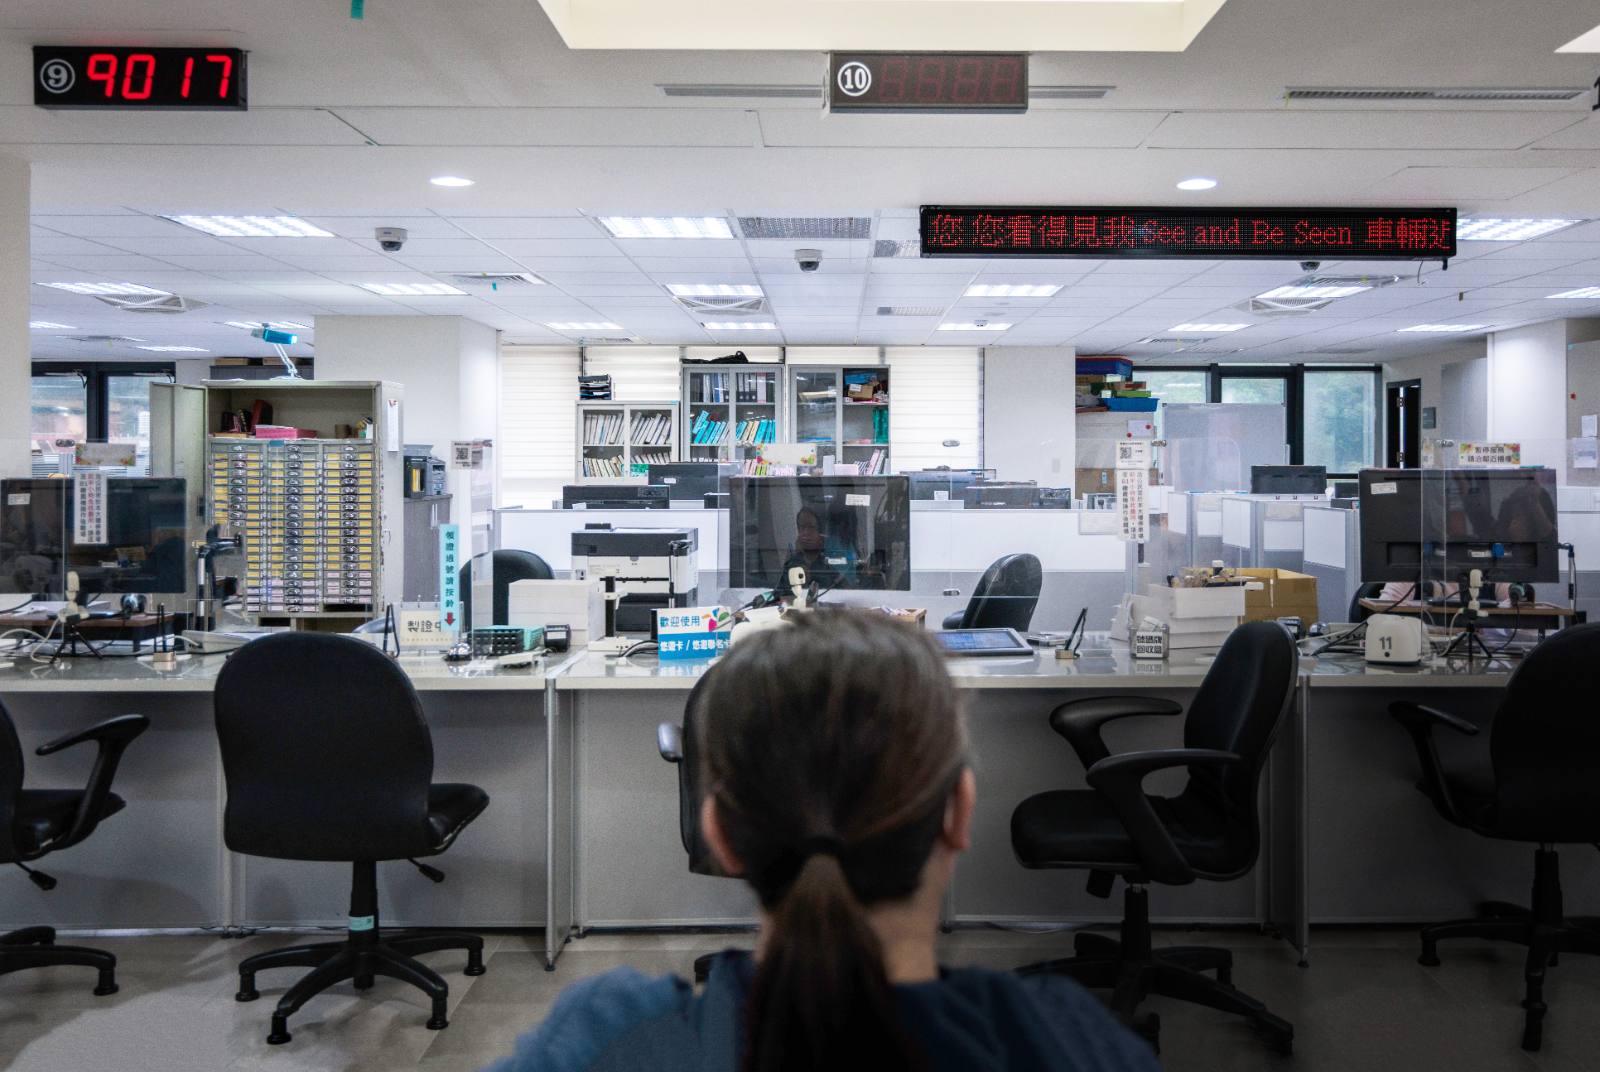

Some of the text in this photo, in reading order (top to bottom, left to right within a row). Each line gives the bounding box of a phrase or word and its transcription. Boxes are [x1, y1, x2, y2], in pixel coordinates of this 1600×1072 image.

[47, 64, 68, 88] 9
[844, 67, 867, 90] 10
[1143, 219, 1185, 244] See
[1194, 217, 1240, 244] and
[1252, 219, 1285, 245] Be
[1294, 218, 1353, 245] Seen
[660, 615, 700, 627] 歡迎使用
[1378, 636, 1392, 650] 11
